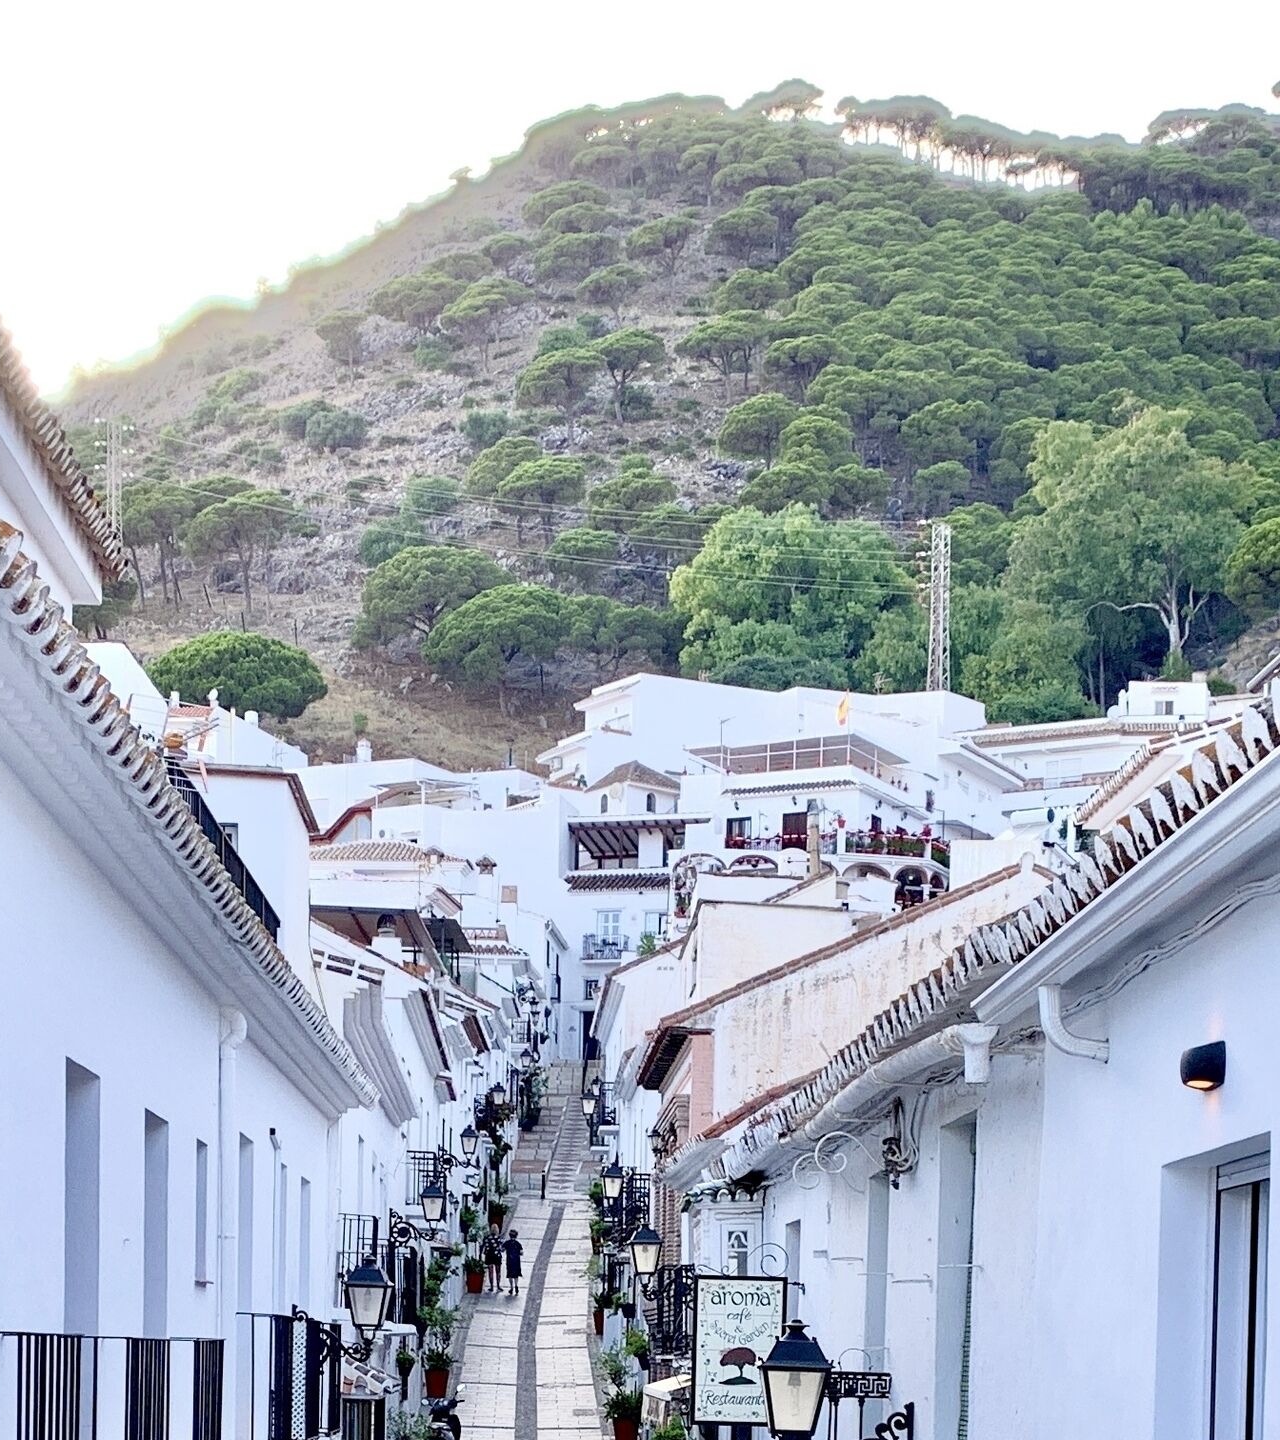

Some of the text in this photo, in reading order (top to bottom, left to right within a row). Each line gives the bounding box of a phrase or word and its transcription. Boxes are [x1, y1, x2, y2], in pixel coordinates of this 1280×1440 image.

[711, 1290, 771, 1306] aroma
[727, 1308, 752, 1324] café
[739, 1322, 770, 1345] Garden
